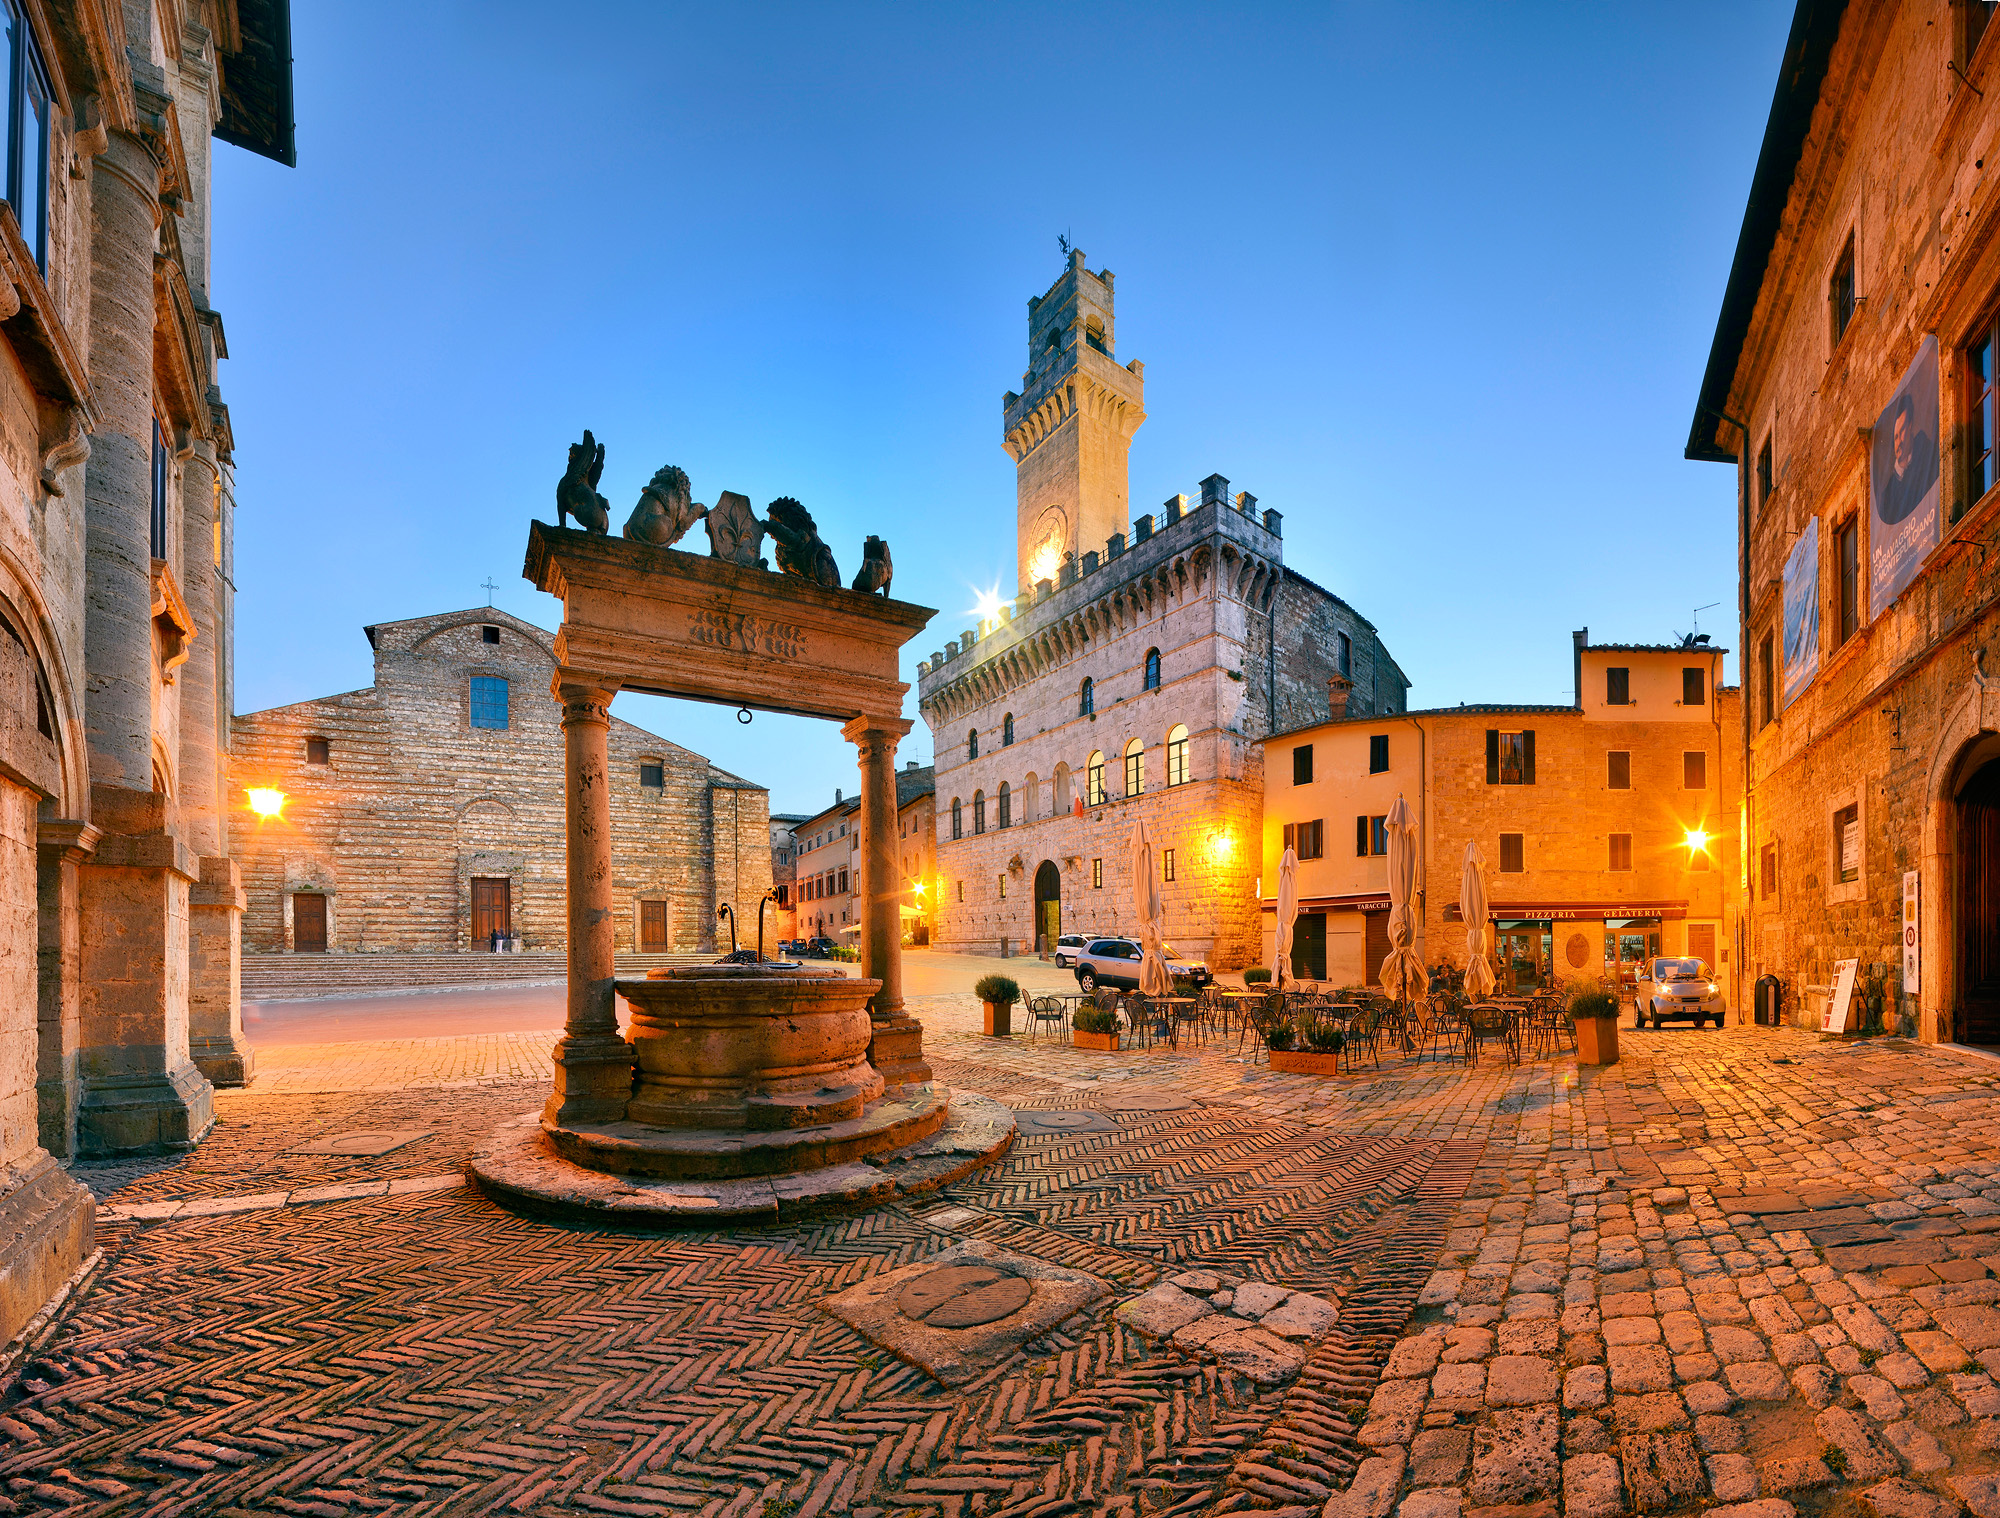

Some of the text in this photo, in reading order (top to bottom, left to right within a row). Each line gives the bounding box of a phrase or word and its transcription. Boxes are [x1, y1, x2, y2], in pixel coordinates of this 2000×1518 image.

[1872, 545, 1882, 563] UN
[1873, 516, 1916, 576] CARAVAGGIO
[1878, 508, 1935, 584] MONTEPULCIANO
[1357, 902, 1389, 910] TABACCHI
[1525, 910, 1662, 919] PIZZERIA GELATERIA
